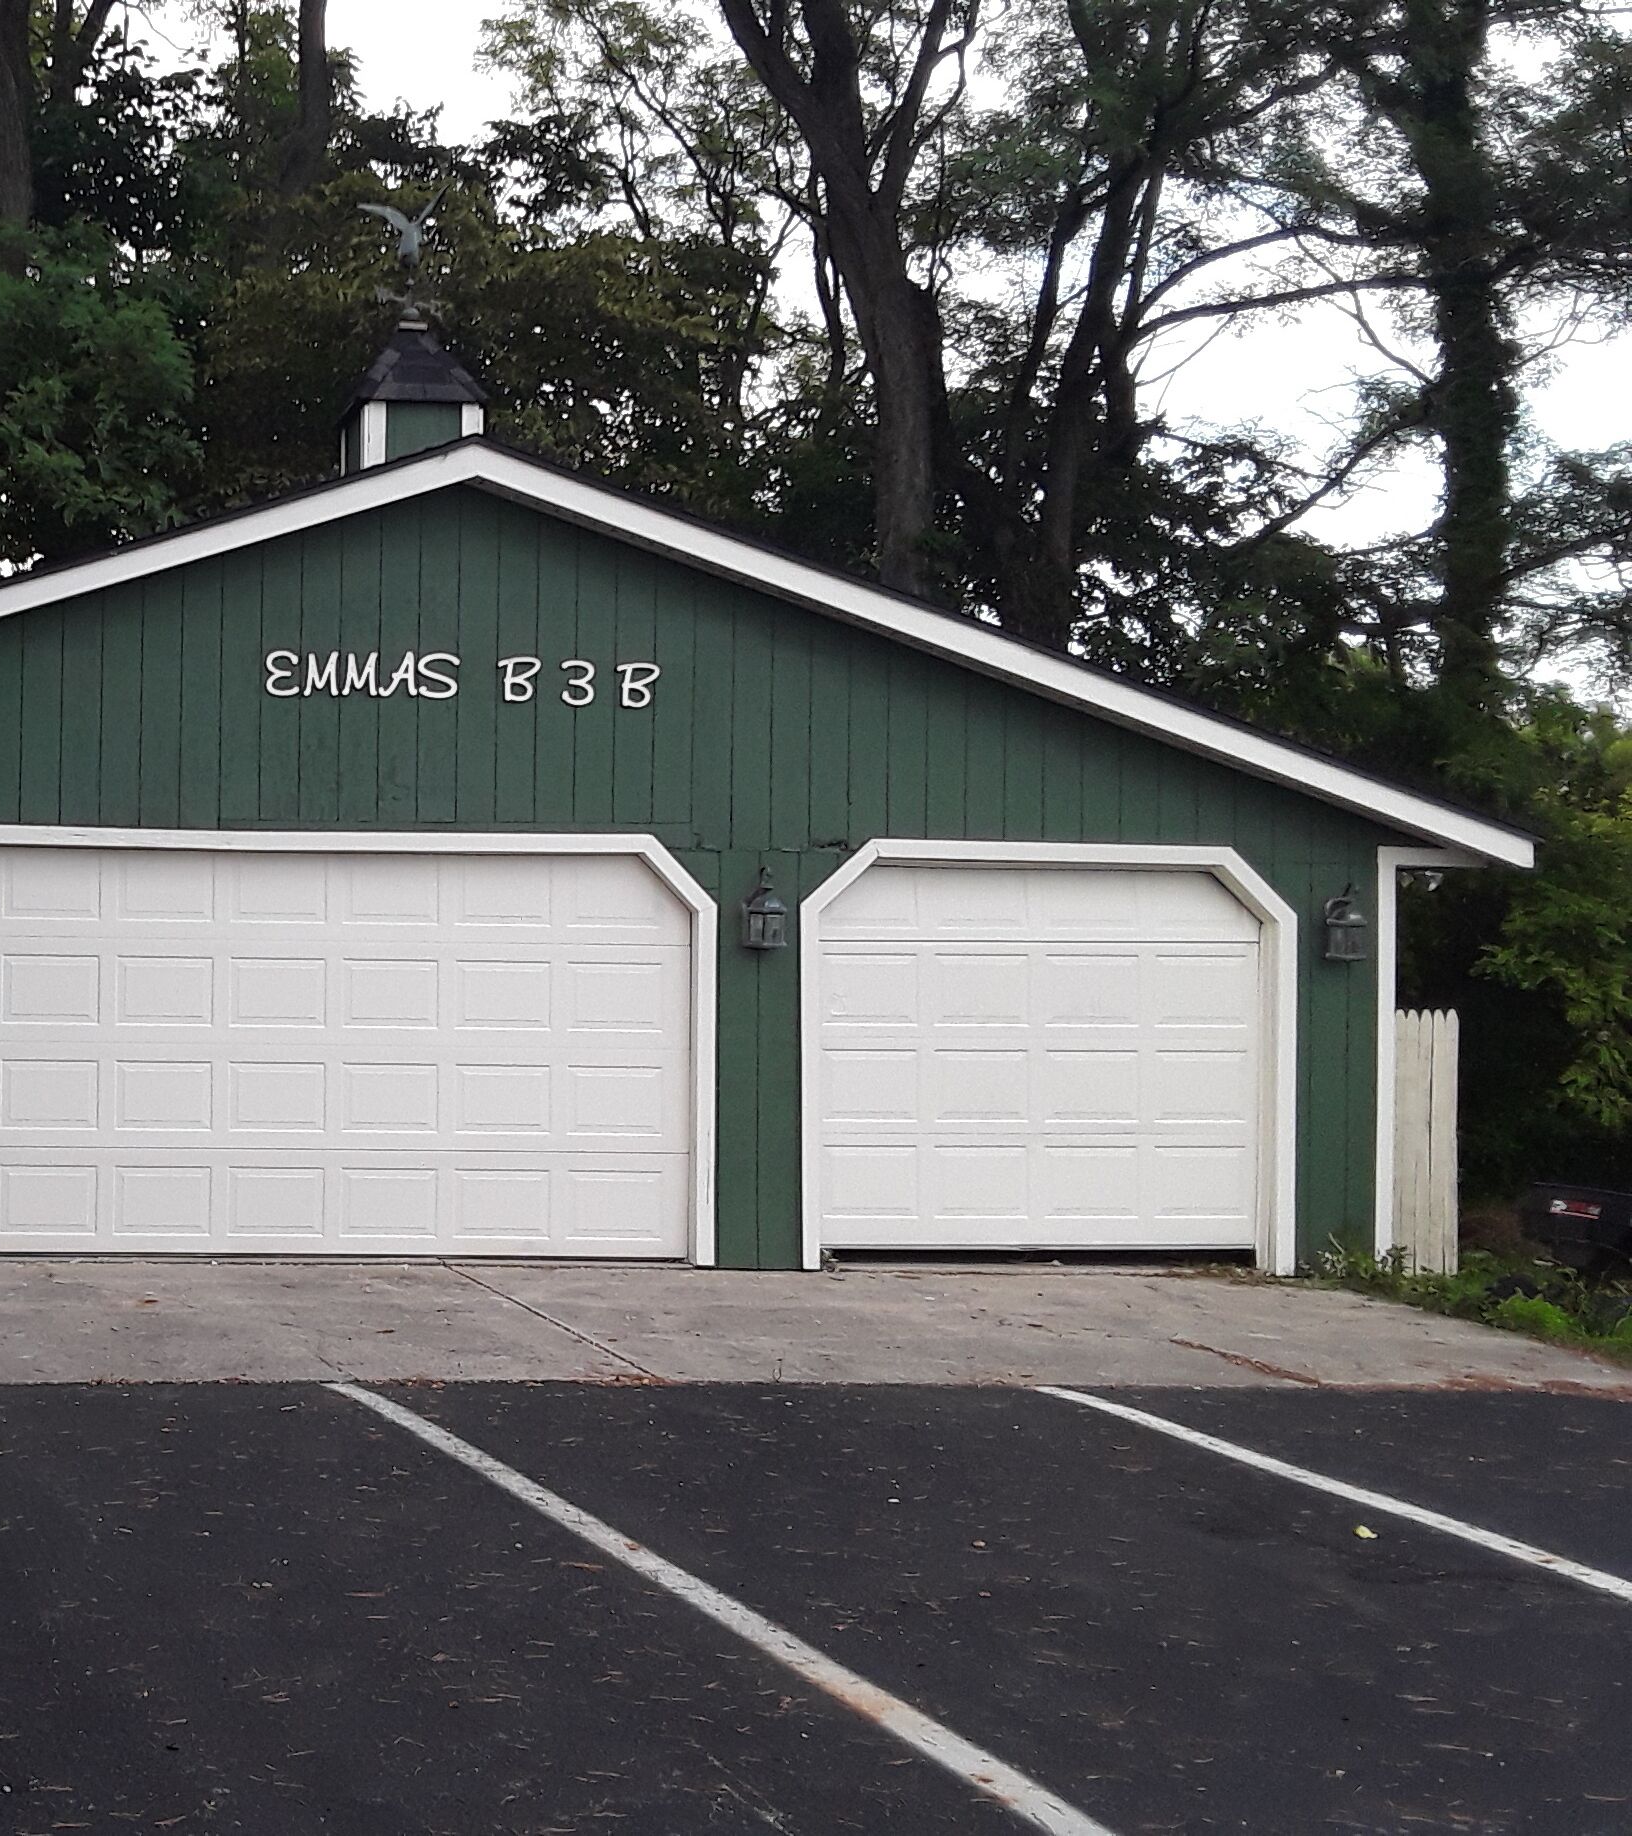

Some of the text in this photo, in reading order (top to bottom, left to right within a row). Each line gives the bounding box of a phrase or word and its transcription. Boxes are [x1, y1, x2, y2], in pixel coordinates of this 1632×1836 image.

[266, 650, 661, 708] EMMAS B 3 B
